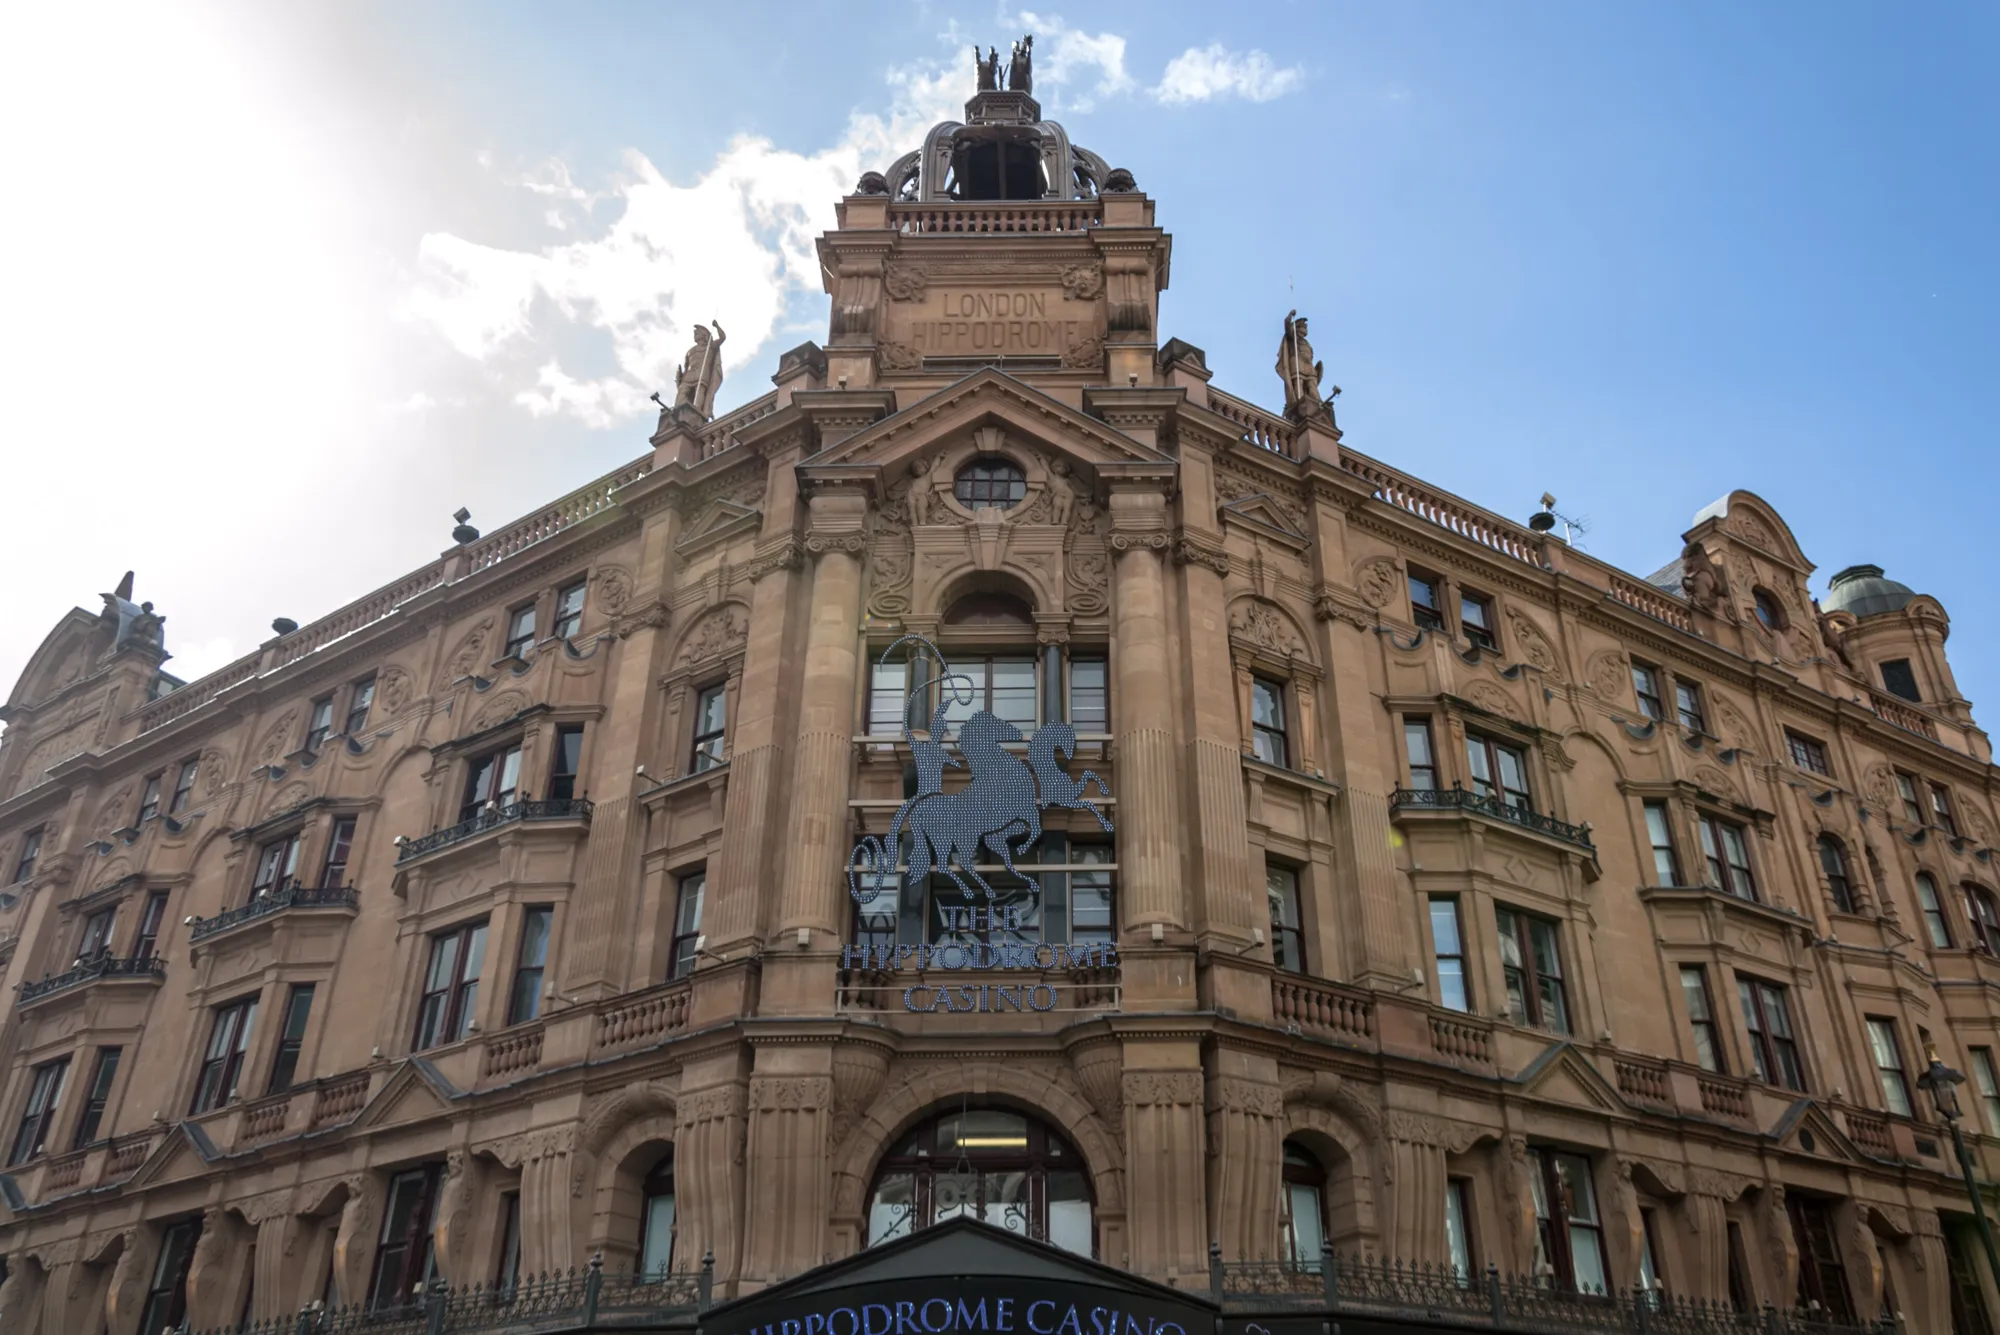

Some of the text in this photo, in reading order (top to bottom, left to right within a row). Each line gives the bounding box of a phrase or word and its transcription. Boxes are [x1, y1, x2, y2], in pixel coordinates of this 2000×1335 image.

[943, 292, 1046, 318] LONDON
[911, 320, 1079, 350] HIPPODROME
[941, 905, 1021, 932] THE
[842, 941, 1119, 971] HIPPODROME
[903, 983, 1058, 1013] CASINO
[734, 1297, 1014, 1335] PPODROME
